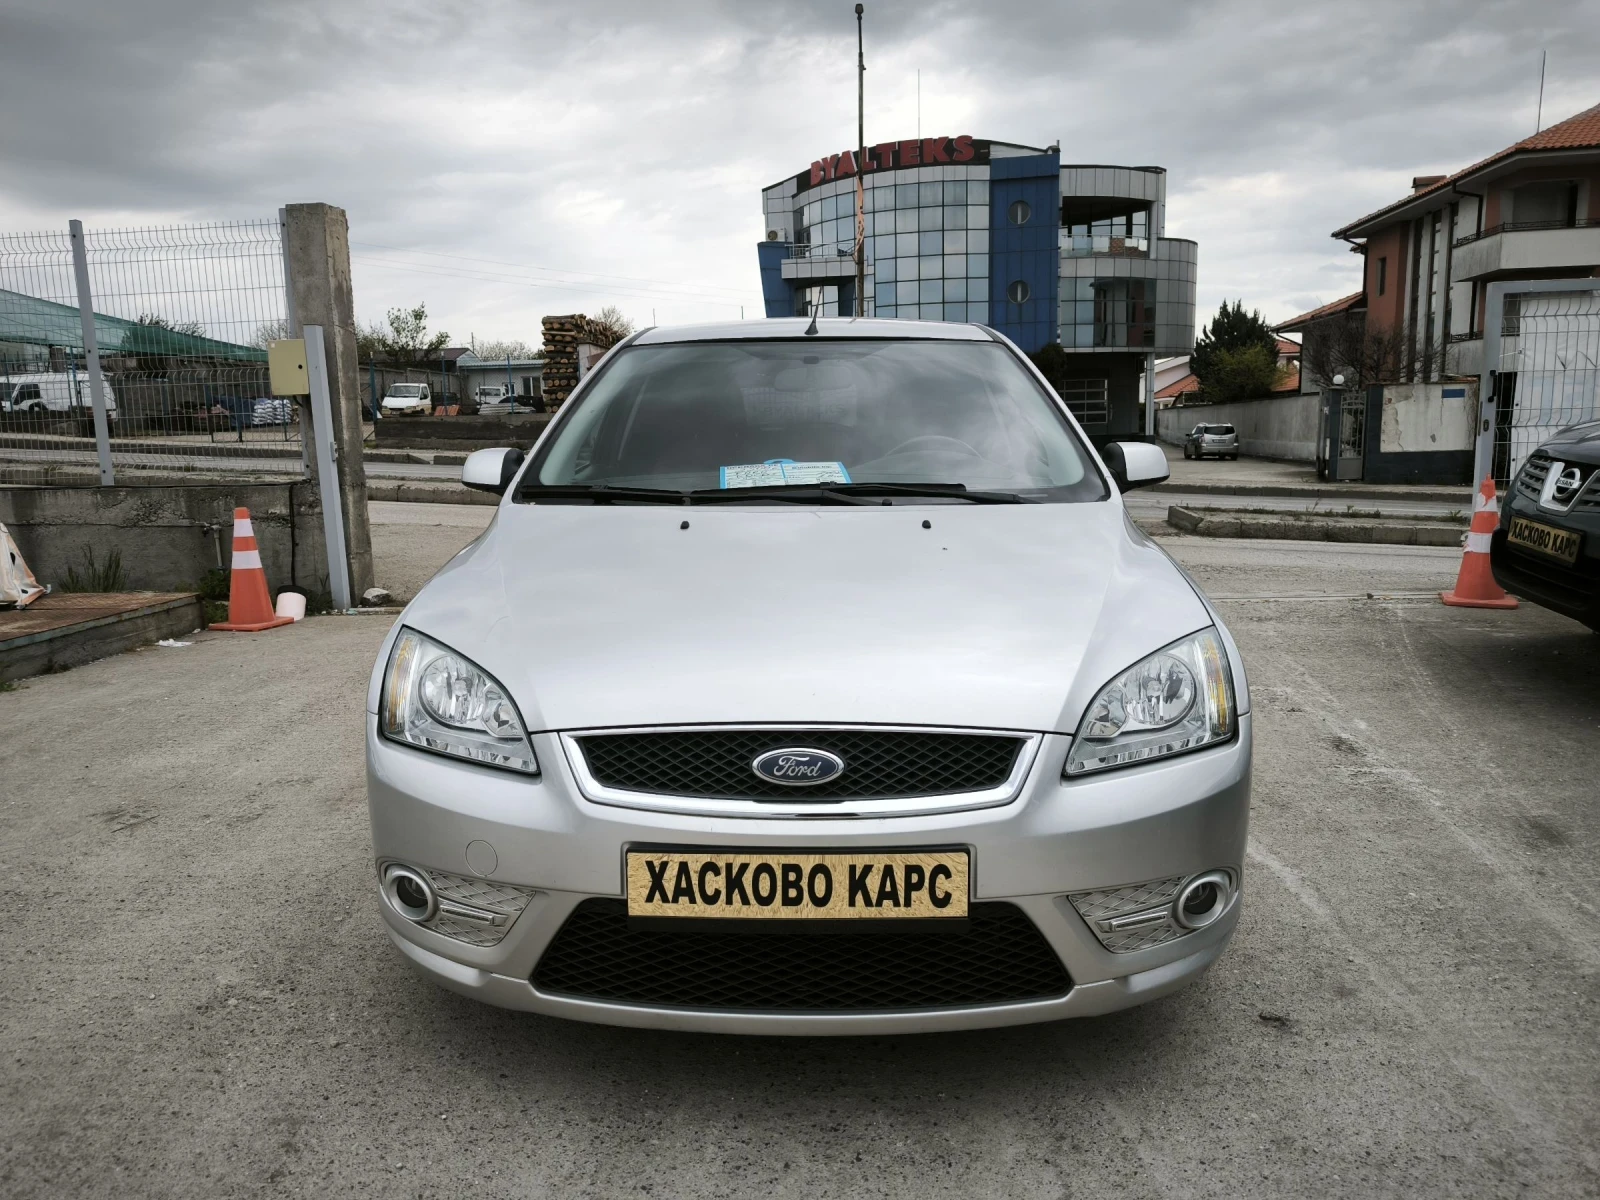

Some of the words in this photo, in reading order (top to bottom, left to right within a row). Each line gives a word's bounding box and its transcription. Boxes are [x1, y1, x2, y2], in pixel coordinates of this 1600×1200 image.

[810, 135, 975, 186] BYALTEKS
[1511, 521, 1551, 548] ХАСКОВО
[1551, 533, 1577, 557] КАРС
[773, 756, 821, 777] Ford
[645, 860, 834, 907] ХАСКОВО
[848, 863, 953, 908] КАРС
